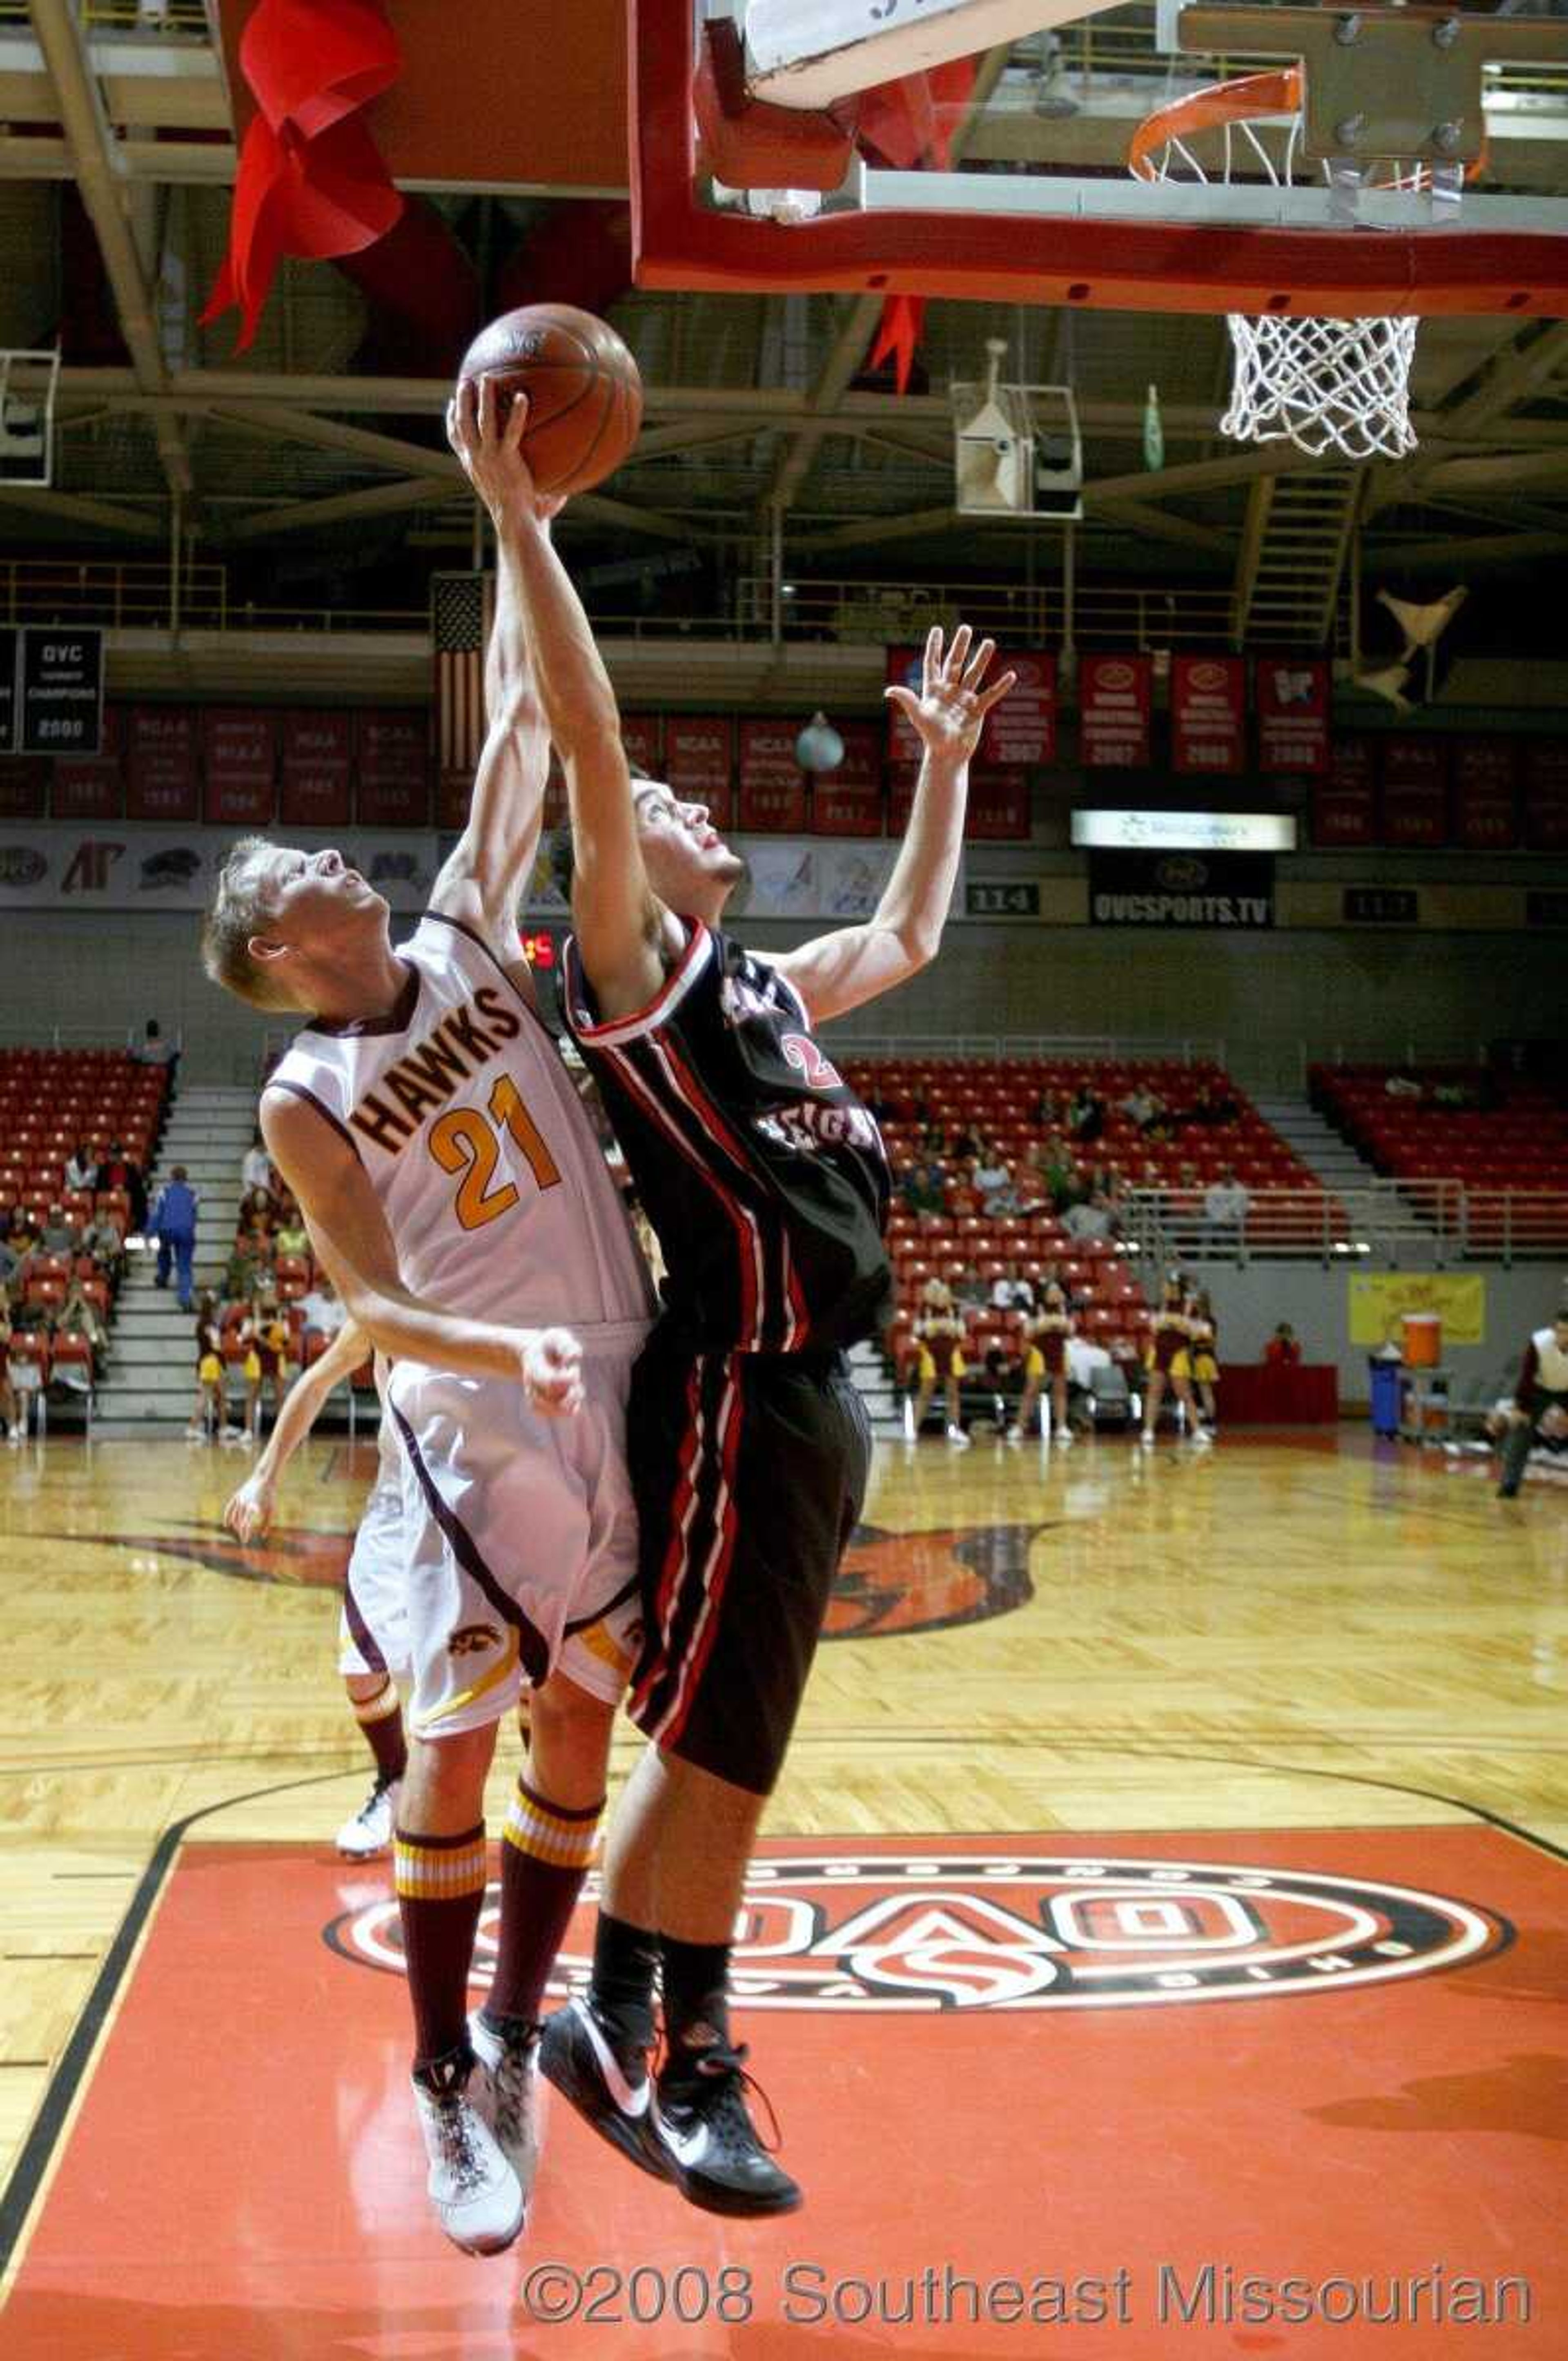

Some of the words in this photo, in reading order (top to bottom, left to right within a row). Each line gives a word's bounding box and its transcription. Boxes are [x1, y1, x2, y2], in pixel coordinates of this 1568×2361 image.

[42, 644, 83, 662] OVC
[975, 889, 1029, 911] 114
[1094, 893, 1266, 924] OVCSPORTS.TV
[348, 987, 521, 1156] HAWKS
[428, 1072, 562, 1232] 21
